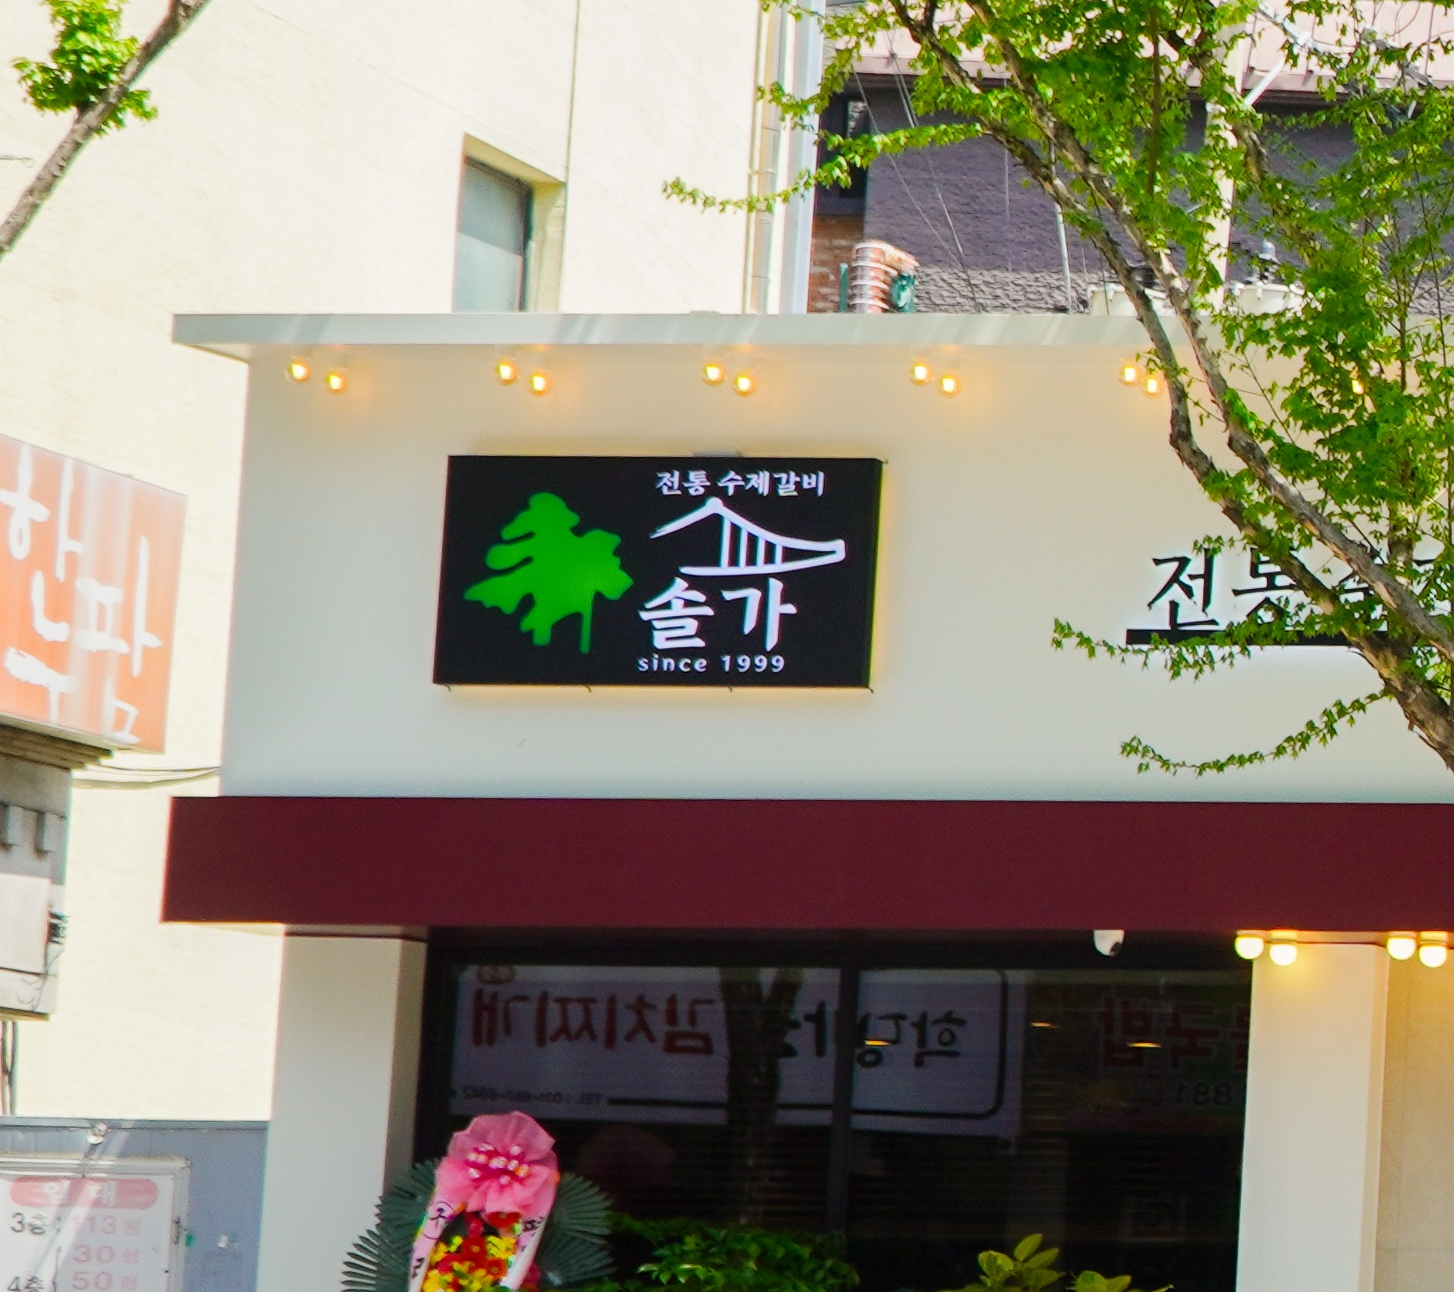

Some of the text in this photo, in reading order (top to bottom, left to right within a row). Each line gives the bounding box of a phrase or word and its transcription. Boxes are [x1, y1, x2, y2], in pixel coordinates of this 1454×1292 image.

[656, 470, 825, 497] 전통 수제갈비
[638, 577, 797, 652] 솔가
[637, 654, 785, 673] since 1999
